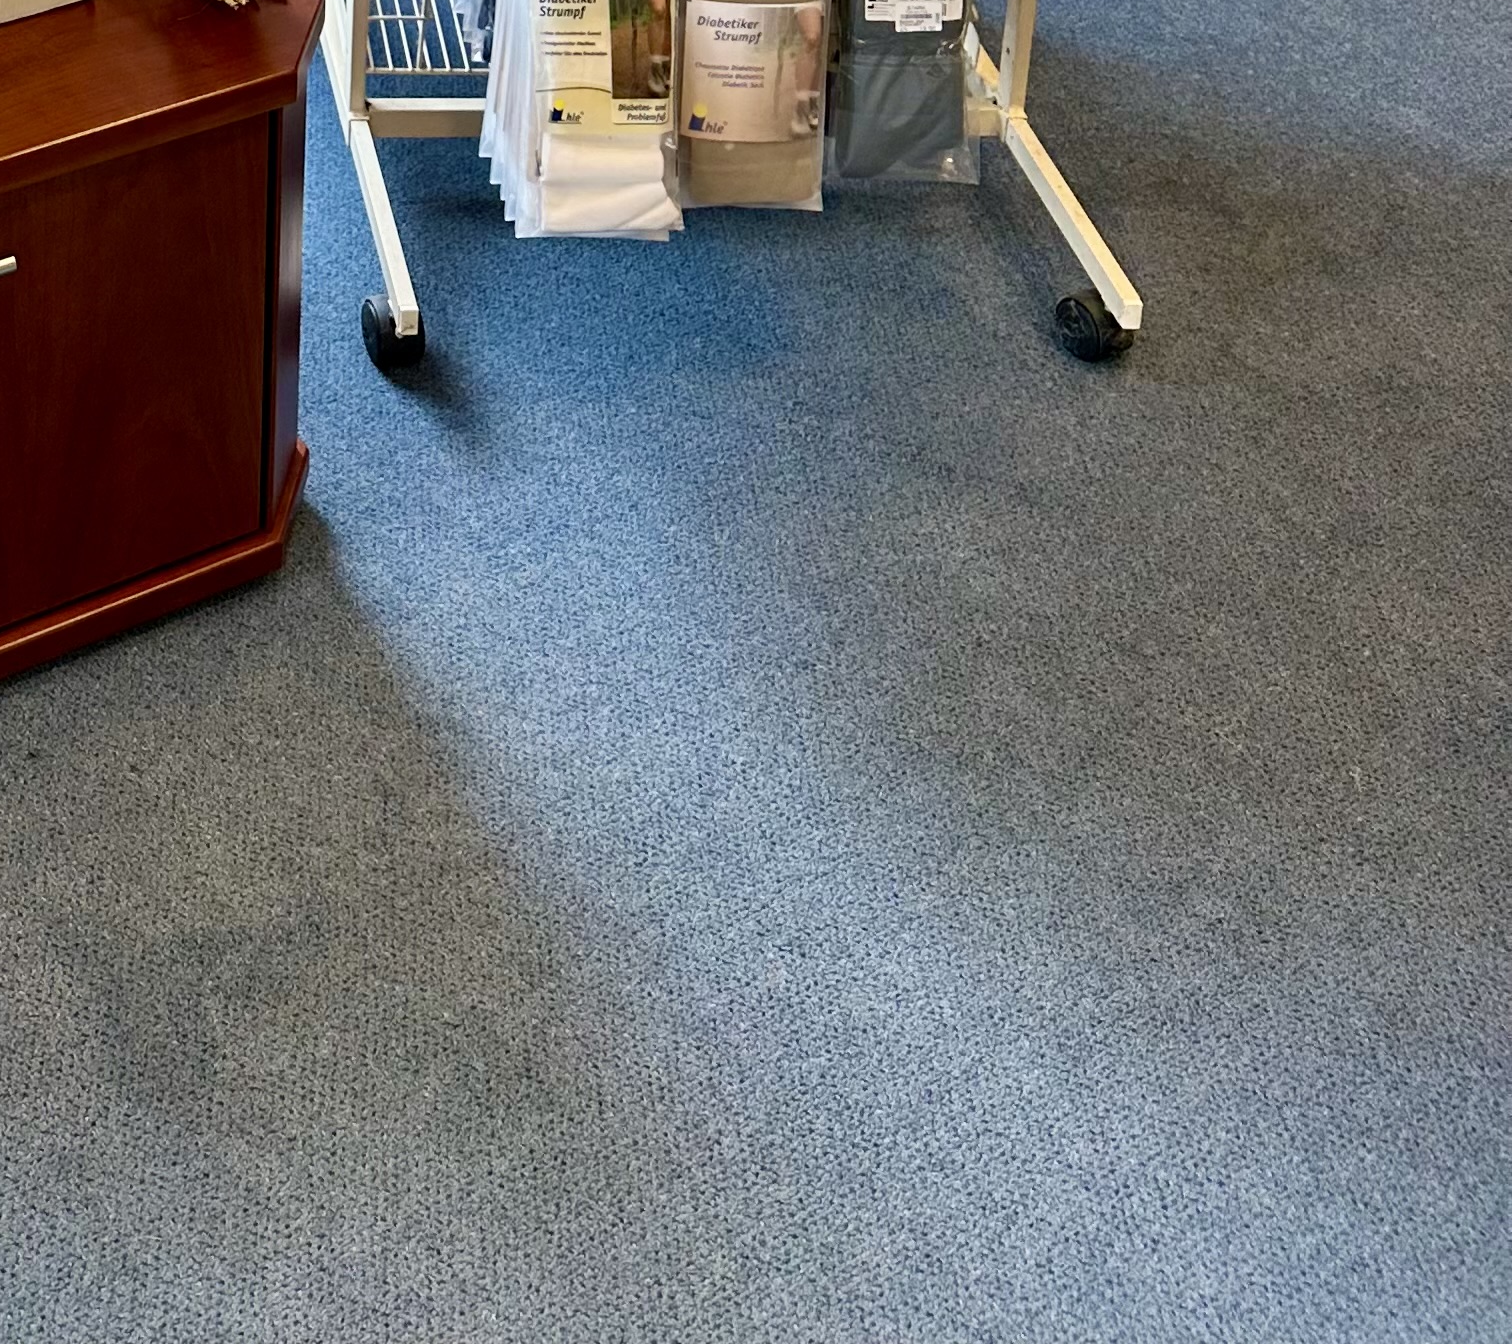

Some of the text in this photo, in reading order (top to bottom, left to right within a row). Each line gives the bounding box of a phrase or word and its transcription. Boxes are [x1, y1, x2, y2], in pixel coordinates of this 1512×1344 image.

[540, 5, 586, 20] Strumpf
[696, 15, 760, 31] Diabetiker
[713, 29, 763, 45] Strumpf
